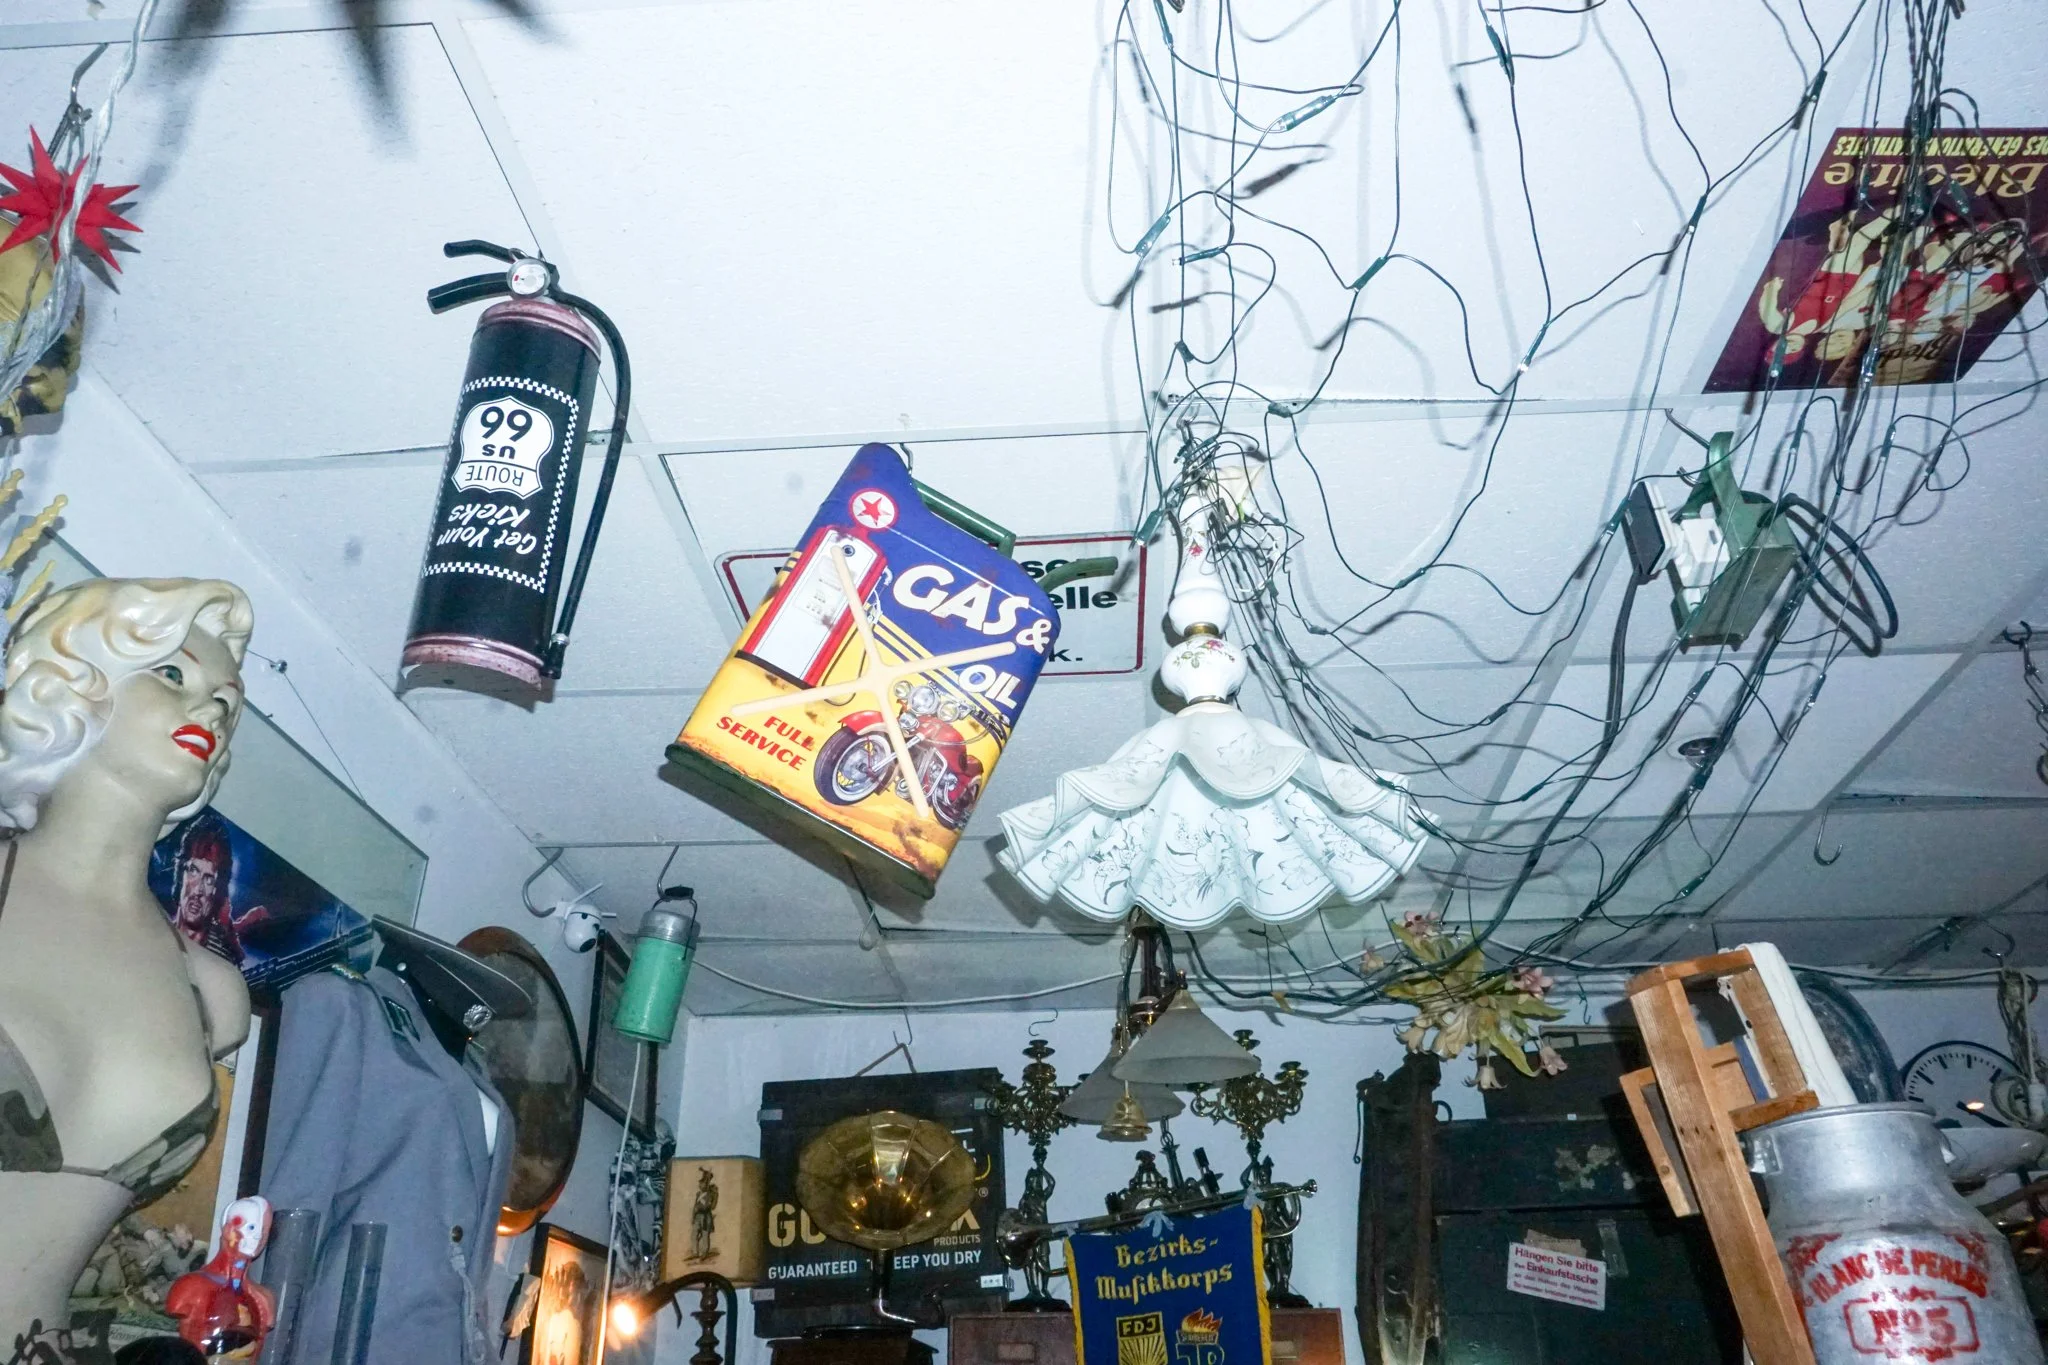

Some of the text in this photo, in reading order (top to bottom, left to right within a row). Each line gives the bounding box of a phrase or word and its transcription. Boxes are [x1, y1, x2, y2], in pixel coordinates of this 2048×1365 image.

[1919, 135, 2023, 159] GÉNÉRATION
[479, 405, 533, 442] 66
[481, 443, 516, 460] US
[464, 464, 525, 487] ROUTE
[447, 502, 531, 529] Kicks
[435, 526, 538, 555] Get Your
[892, 564, 1053, 654] GAS &
[957, 664, 1022, 710] OIL
[715, 715, 809, 772] SERVICE
[763, 715, 815, 752] FULL
[933, 1234, 981, 1247] PRODUCTS
[767, 1259, 858, 1280] GUARANTEED
[892, 1256, 919, 1271] EEP
[922, 1252, 950, 1267] YOU
[954, 1249, 982, 1266] DRY
[1526, 1261, 1599, 1285] Einkaufstasche
[1556, 1255, 1573, 1267] Sie
[1575, 1258, 1599, 1273] bitte
[1121, 1320, 1158, 1335] FDJ
